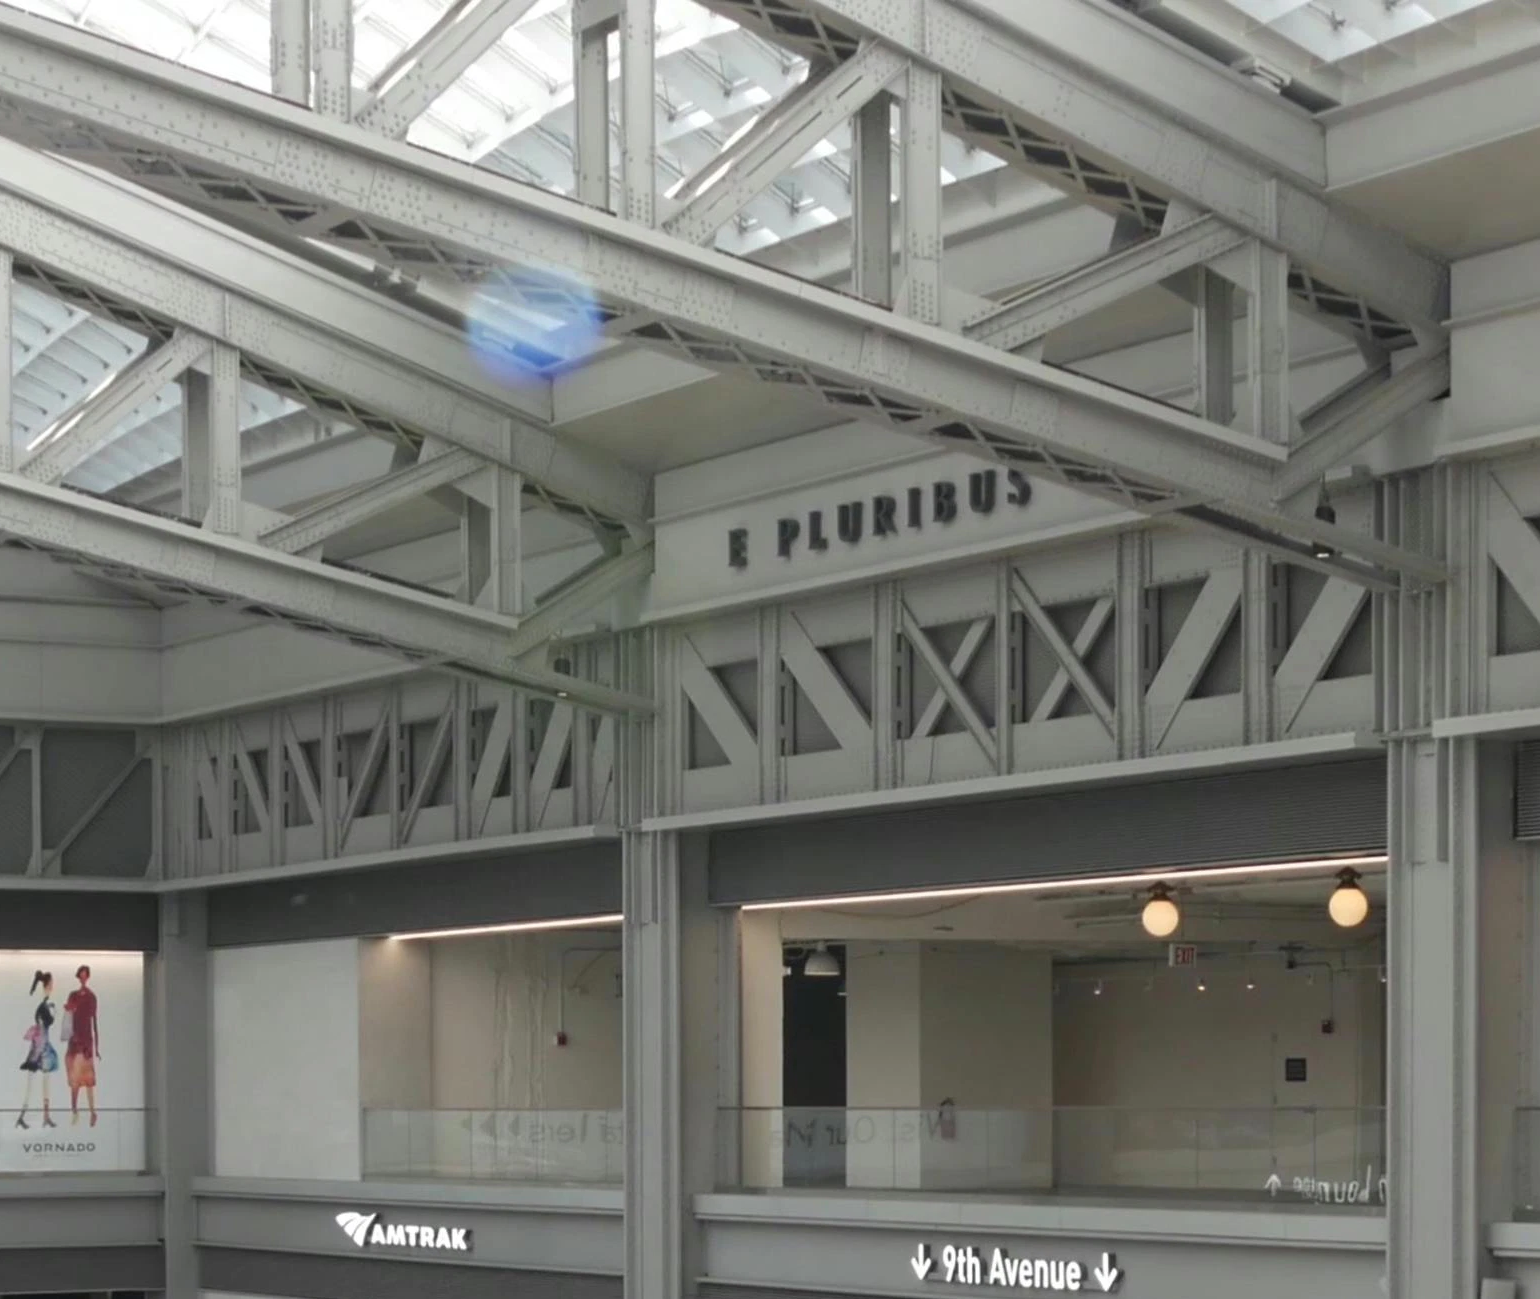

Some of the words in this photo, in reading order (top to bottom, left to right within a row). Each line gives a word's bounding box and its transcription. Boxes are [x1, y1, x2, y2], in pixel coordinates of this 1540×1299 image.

[728, 528, 748, 567] E
[777, 469, 1032, 558] PLURIBUS
[22, 1142, 96, 1154] VORNADO
[371, 1223, 468, 1251] AMTRAK
[942, 1244, 981, 1285] 9th
[989, 1247, 1083, 1291] Avenue
